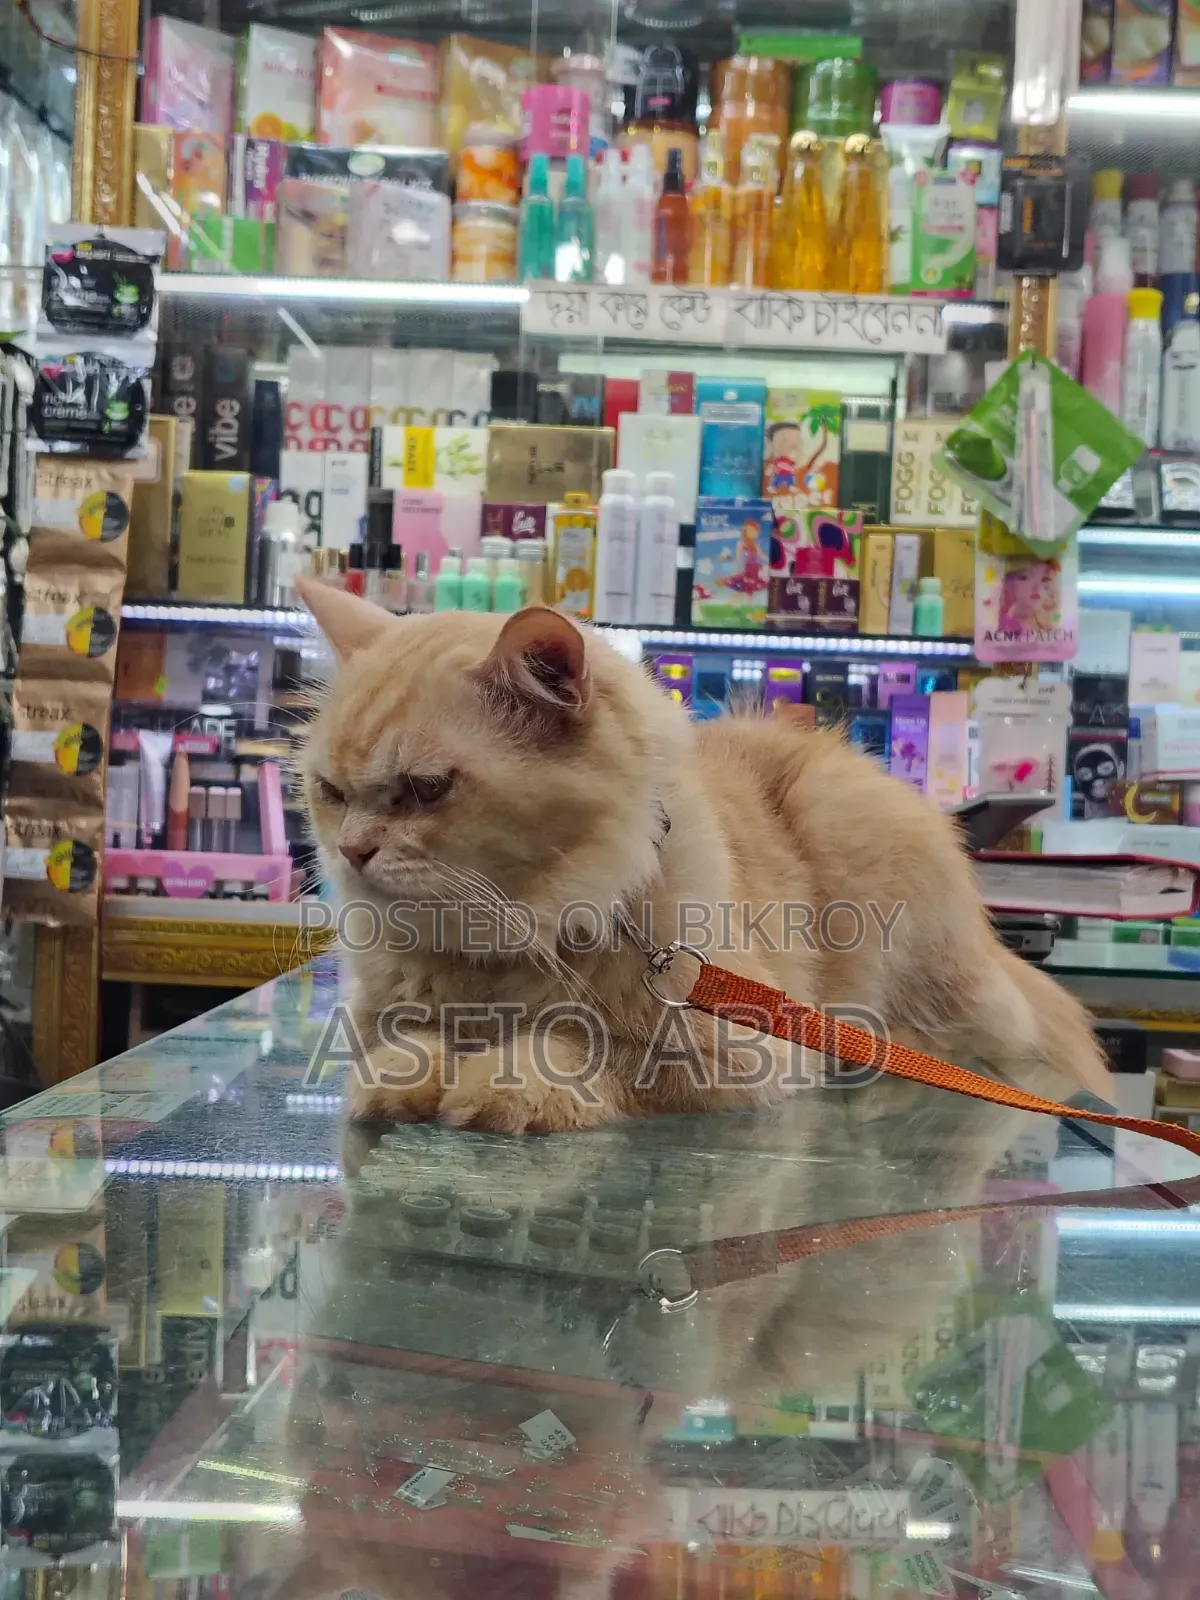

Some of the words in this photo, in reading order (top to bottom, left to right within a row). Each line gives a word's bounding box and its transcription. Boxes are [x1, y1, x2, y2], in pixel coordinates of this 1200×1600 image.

[734, 290, 806, 334] বাকি
[208, 398, 241, 461] vibe
[894, 451, 915, 516] FOGG
[983, 629, 1022, 642] ACNE
[1025, 629, 1074, 642] PATCH
